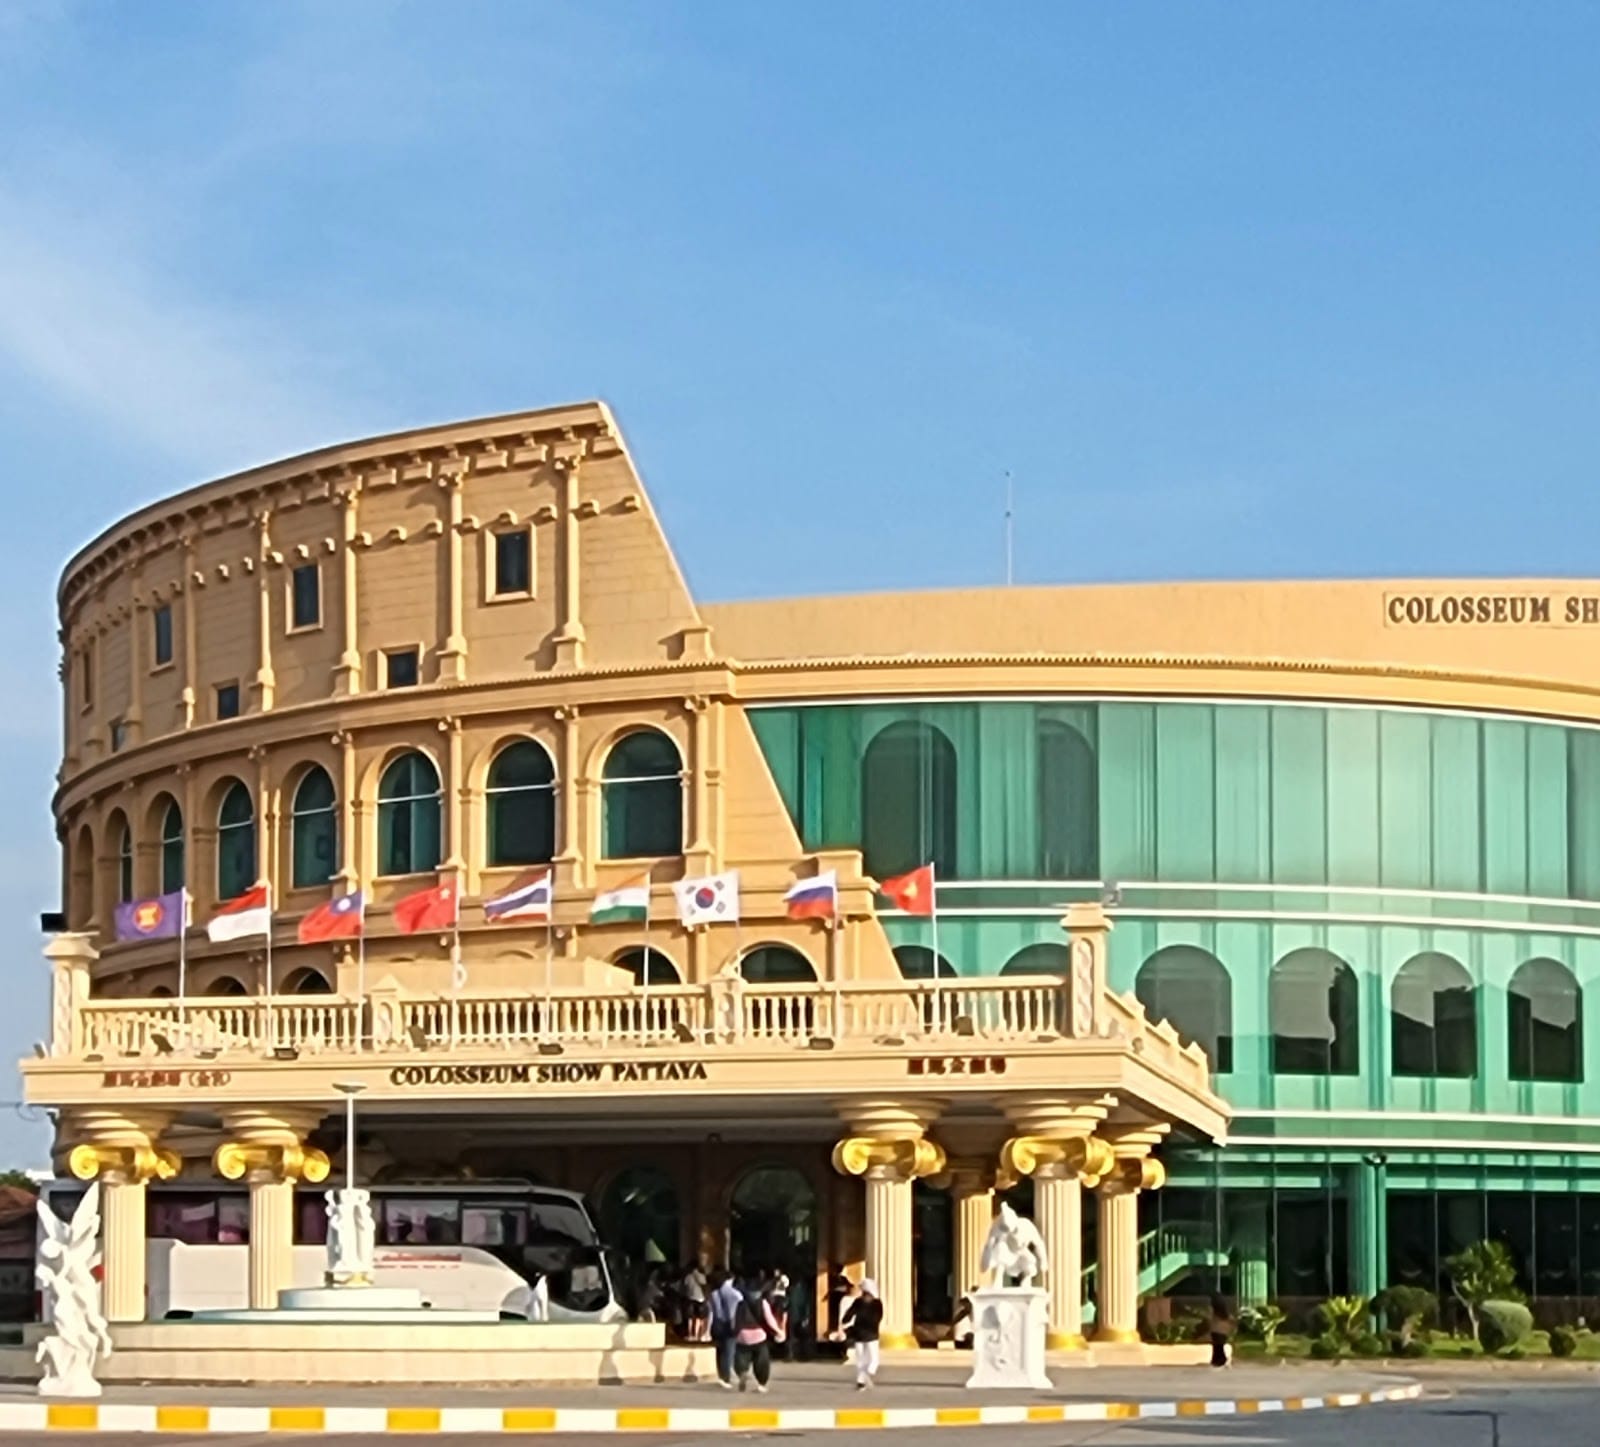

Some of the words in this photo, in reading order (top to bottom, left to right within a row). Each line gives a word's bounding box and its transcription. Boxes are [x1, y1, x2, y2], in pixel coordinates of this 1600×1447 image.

[1388, 596, 1550, 624] COLOSSEUM
[1564, 596, 1600, 624] SH
[390, 1065, 530, 1086] COLOSSEUM
[536, 1063, 602, 1083] SHOW
[611, 1060, 708, 1082] PATTAYA
